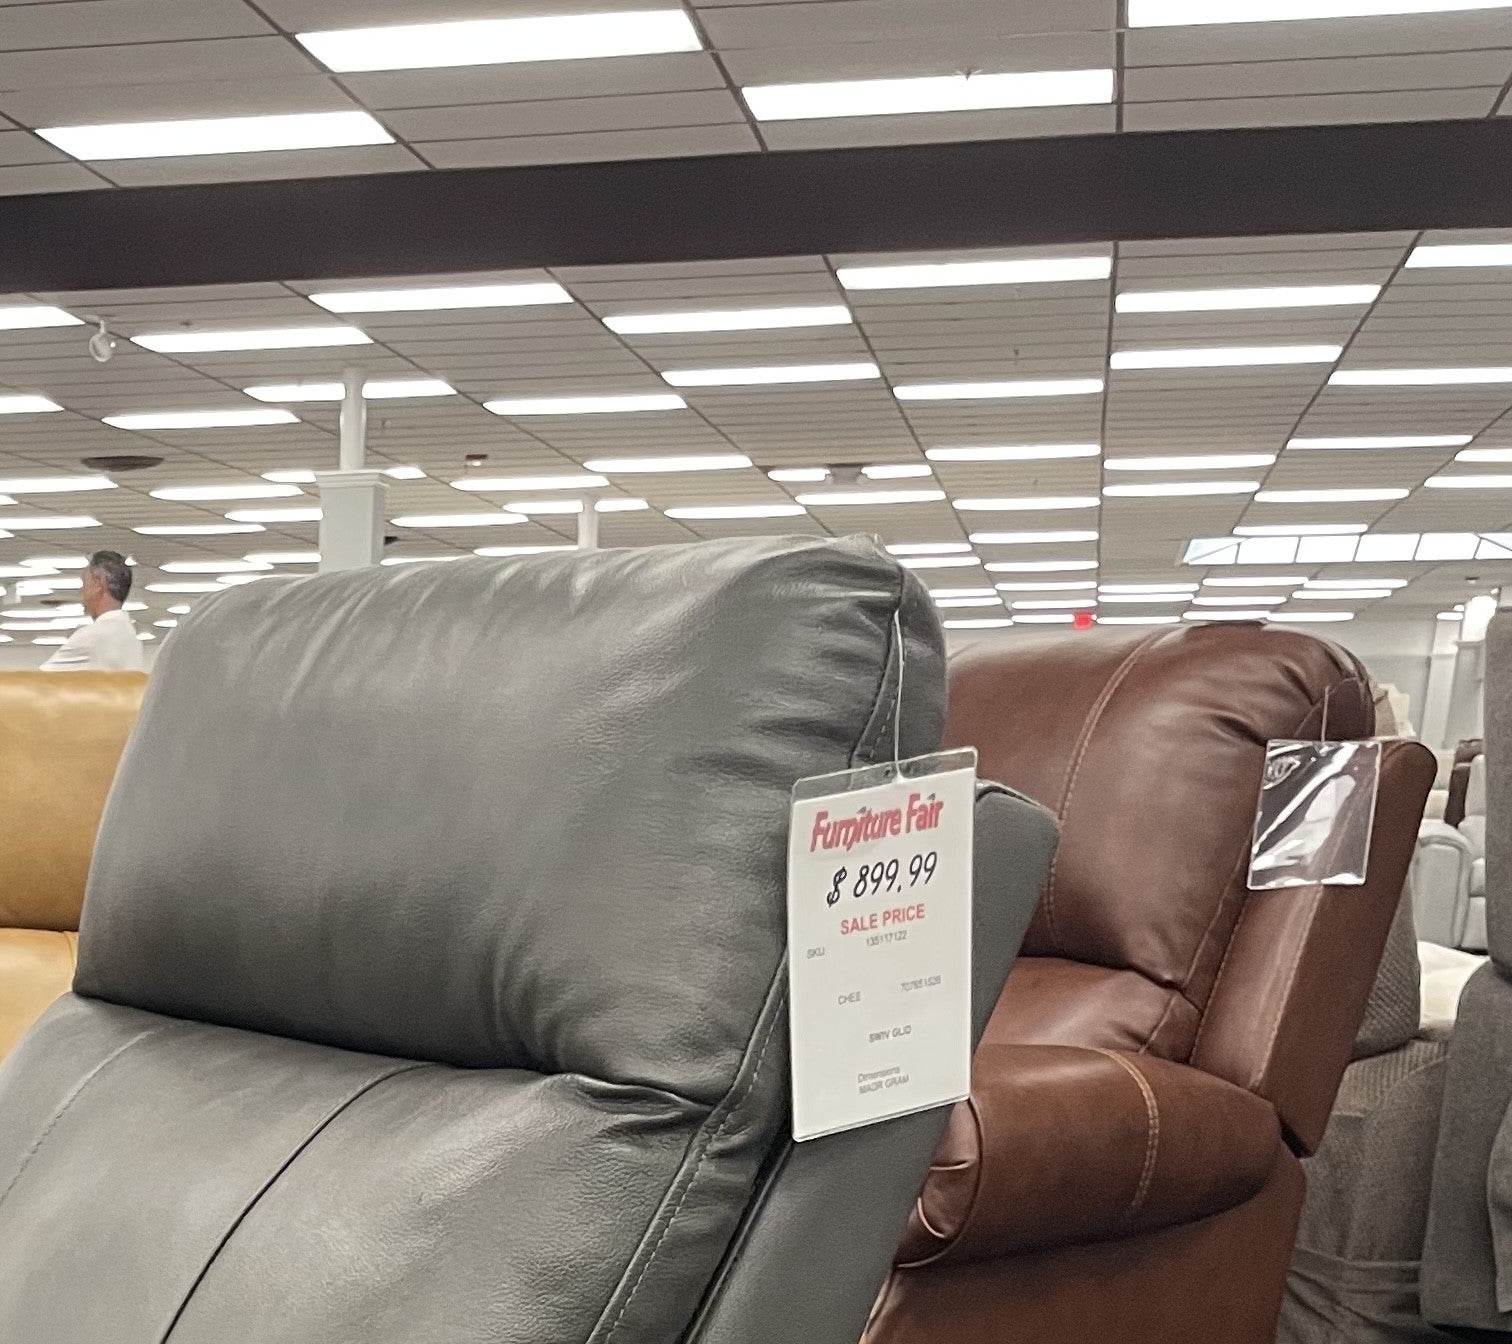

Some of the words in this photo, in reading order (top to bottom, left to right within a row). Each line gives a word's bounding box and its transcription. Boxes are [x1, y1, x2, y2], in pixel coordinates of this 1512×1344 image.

[810, 806, 902, 852] Furniture
[906, 793, 944, 834] Fair
[826, 866, 847, 908] $
[853, 851, 937, 898] 899.99
[840, 913, 878, 935] SALE
[882, 903, 925, 926] PRICE
